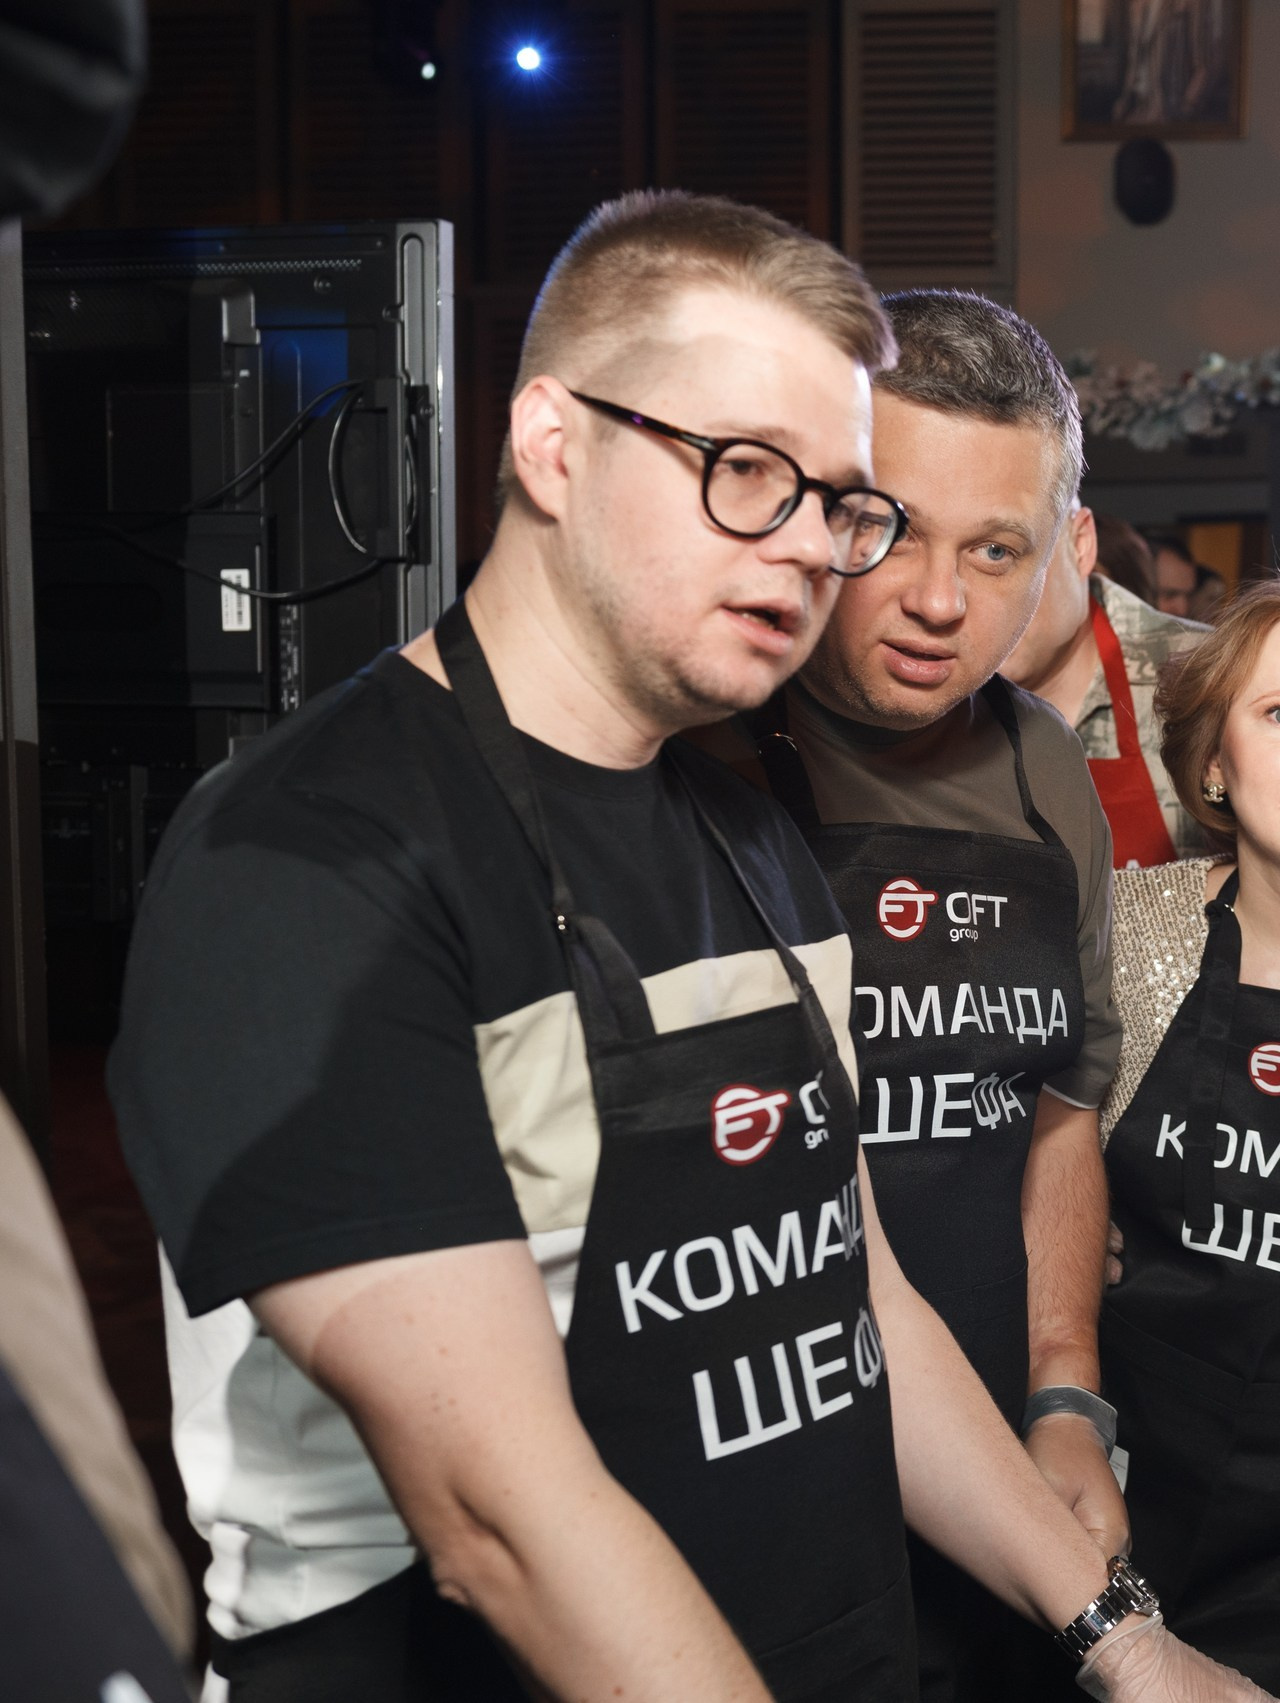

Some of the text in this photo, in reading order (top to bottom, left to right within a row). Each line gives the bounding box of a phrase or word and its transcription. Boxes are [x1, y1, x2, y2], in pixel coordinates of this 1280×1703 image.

[946, 891, 1008, 928] OFT
[949, 927, 979, 942] group
[855, 982, 1068, 1045] ОМАНДА
[692, 1303, 886, 1462] ШЕФ
